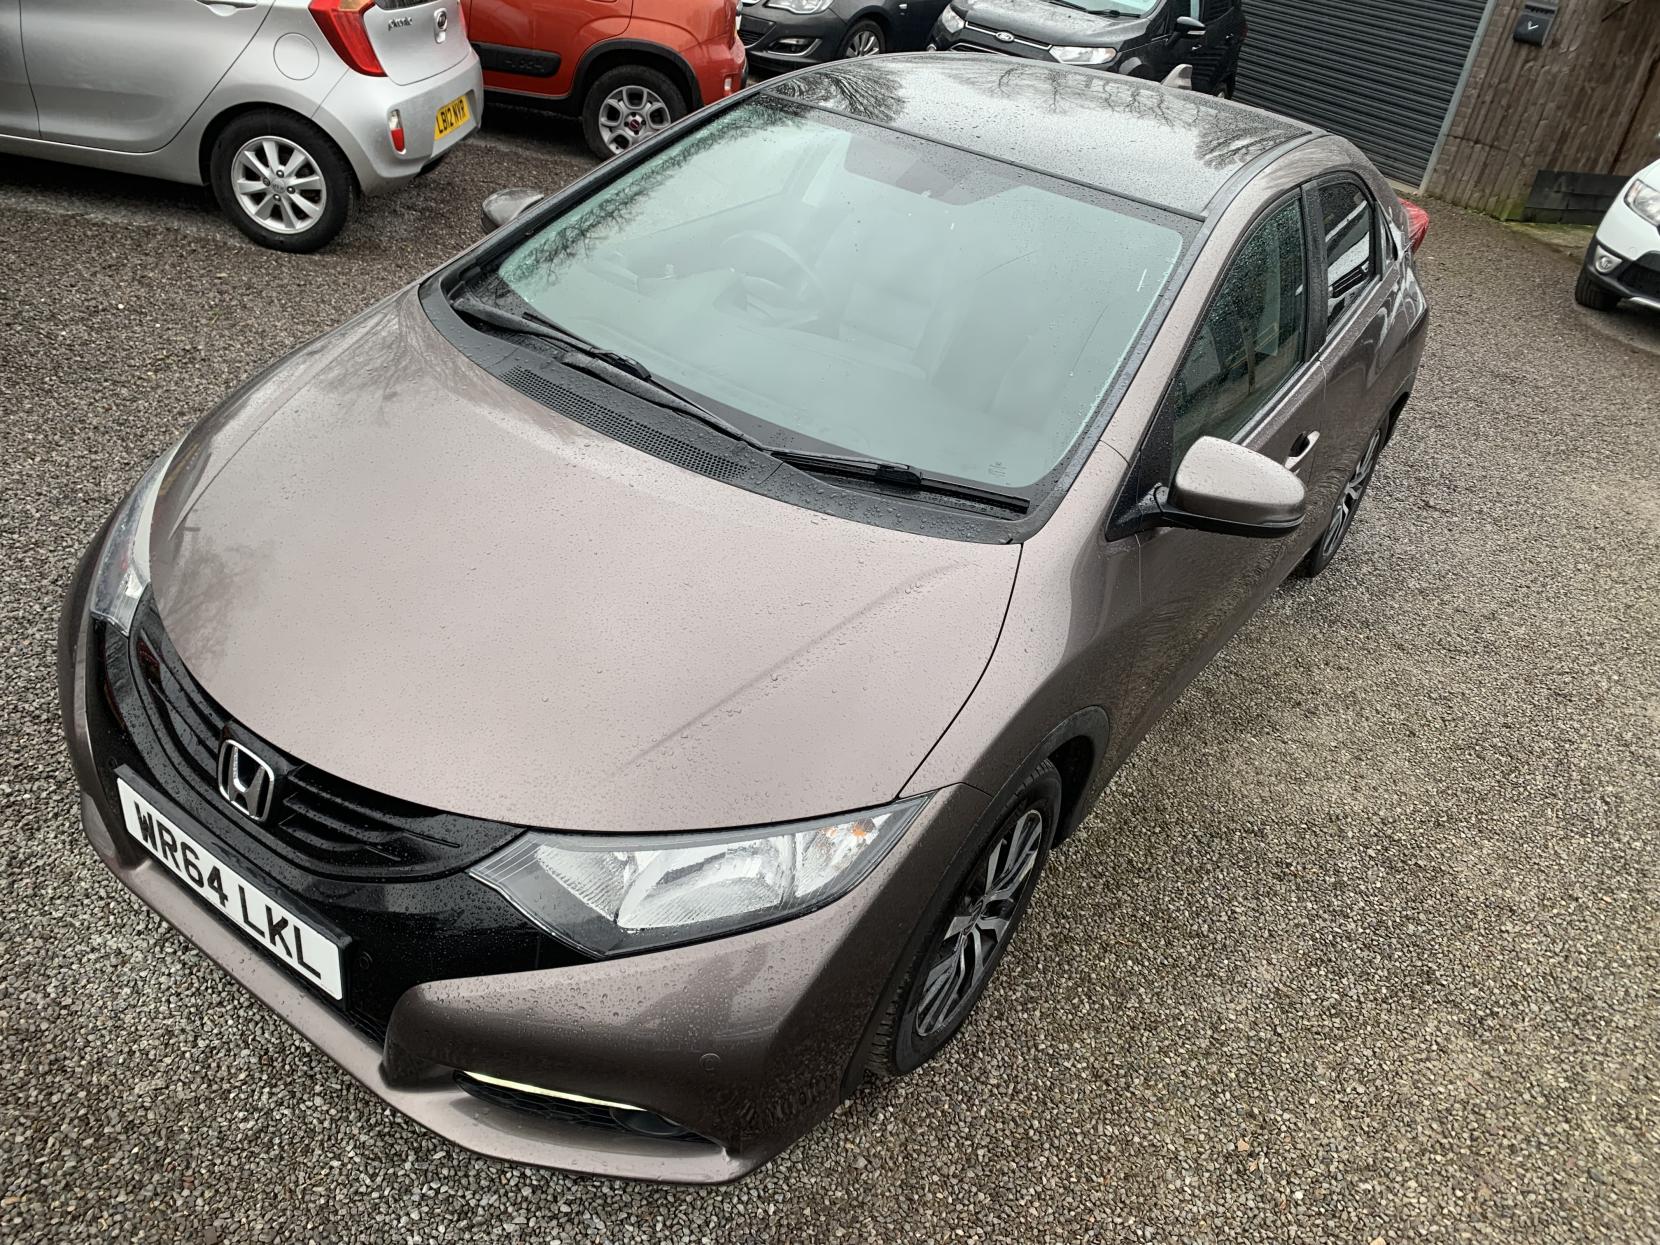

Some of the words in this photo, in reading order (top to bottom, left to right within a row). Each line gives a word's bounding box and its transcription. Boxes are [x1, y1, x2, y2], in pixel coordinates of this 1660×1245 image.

[436, 107, 454, 134] LB12
[134, 800, 229, 908] WR64
[238, 884, 322, 980] LKL
